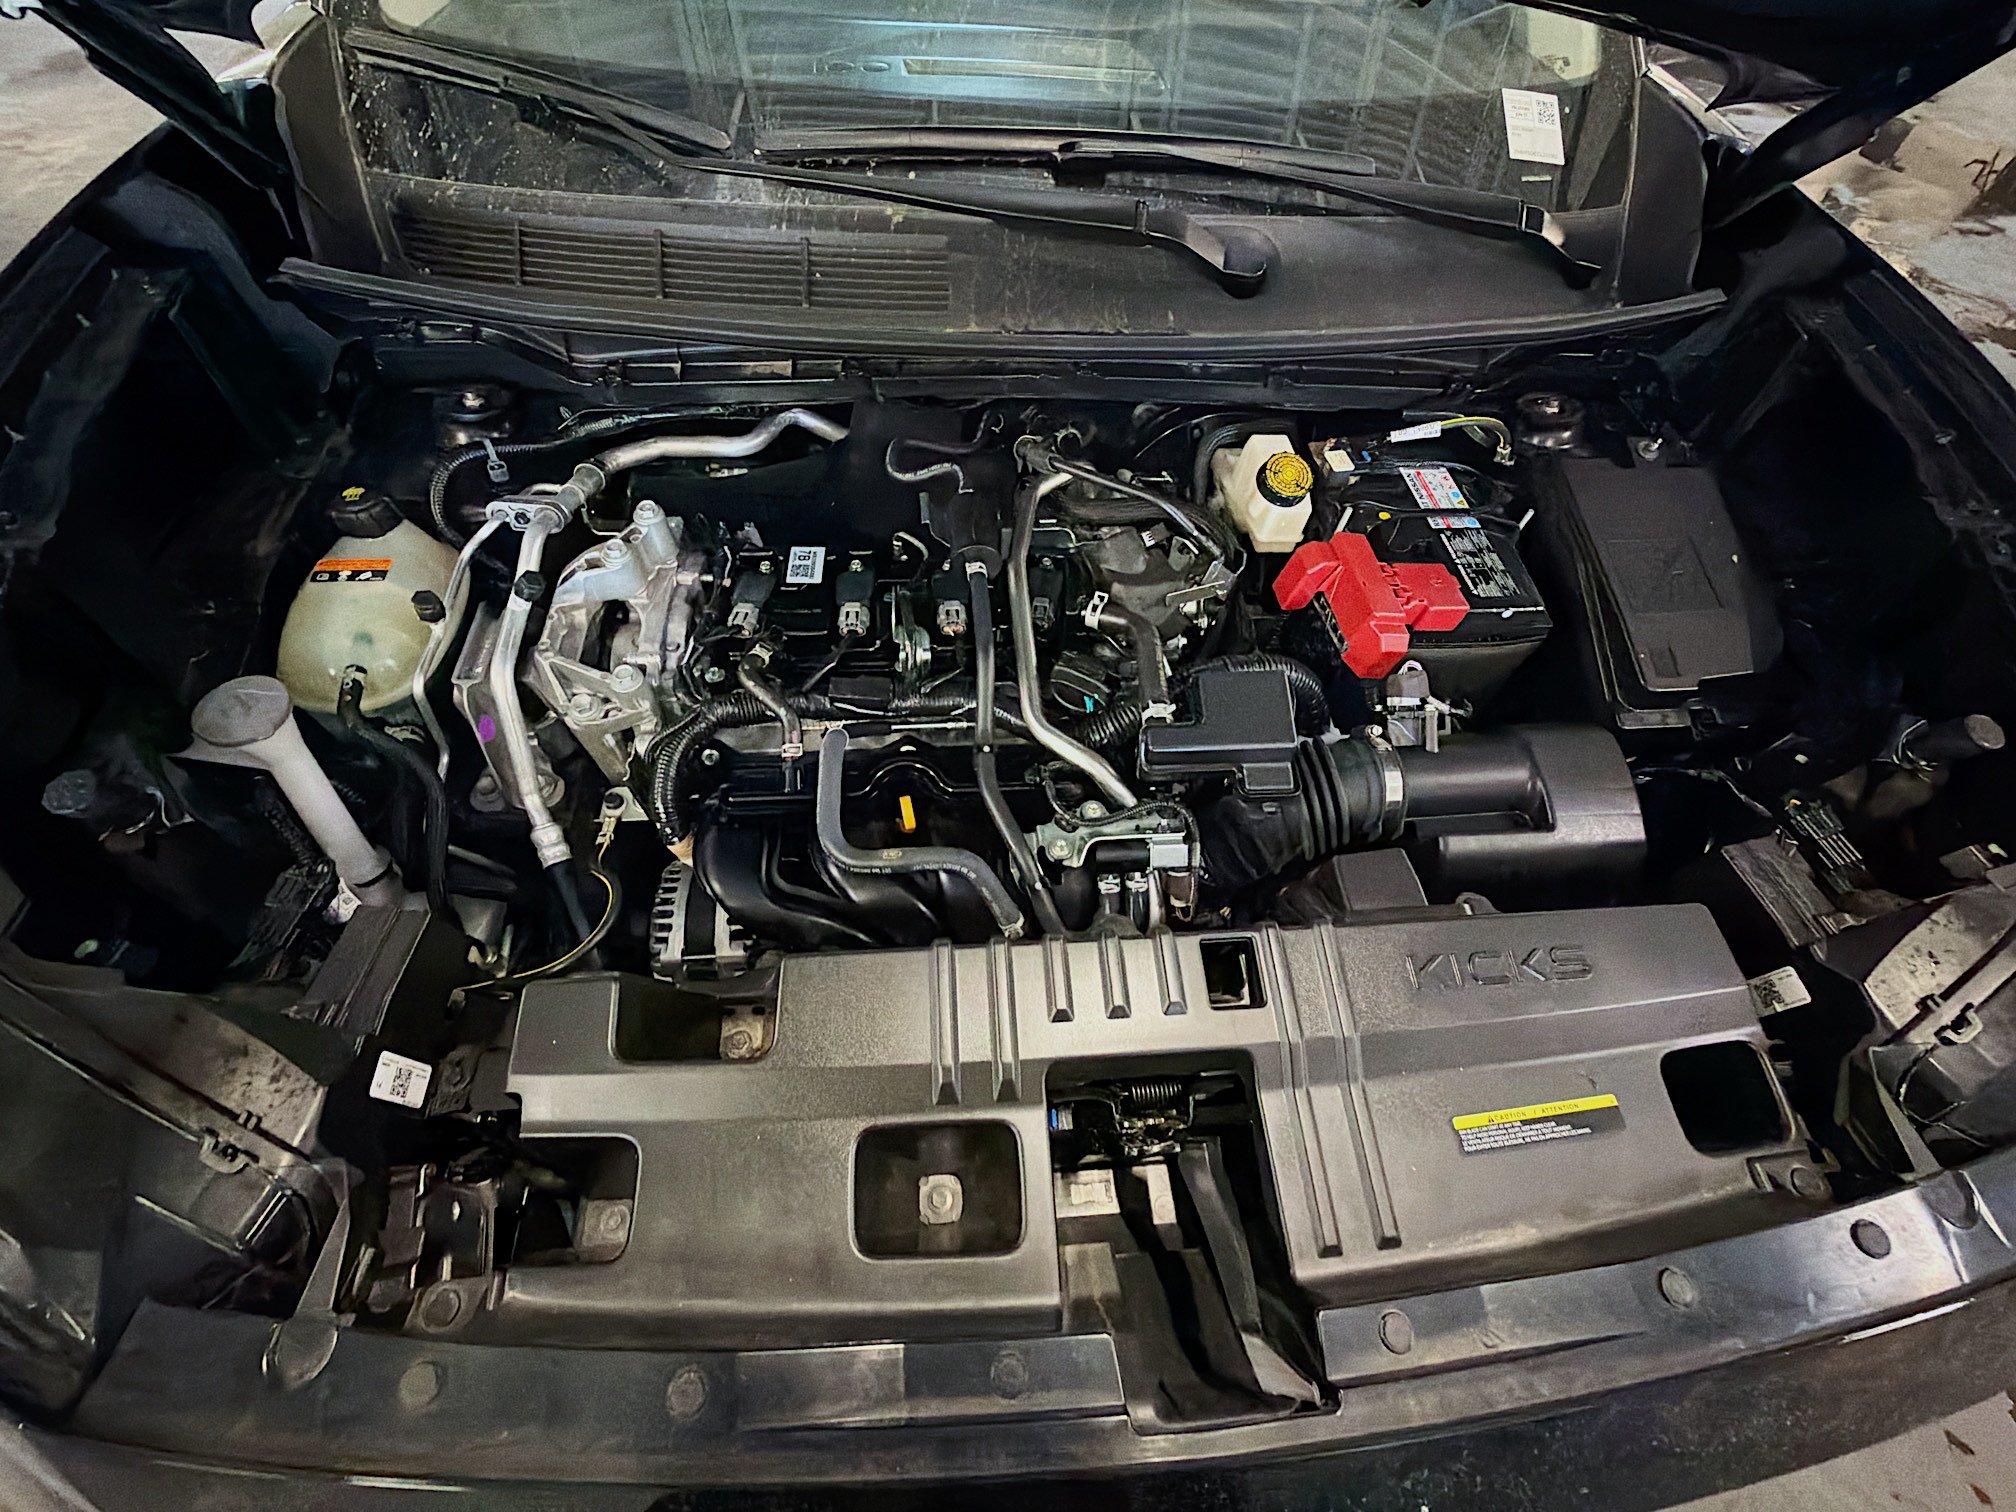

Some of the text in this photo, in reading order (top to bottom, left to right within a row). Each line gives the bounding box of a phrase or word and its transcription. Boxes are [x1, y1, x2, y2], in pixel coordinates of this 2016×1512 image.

[1405, 472, 1426, 500] NISSAN
[1405, 946, 1593, 989] KICKS
[1494, 1111, 1526, 1121] CAUTION
[1541, 1104, 1580, 1114] ATTENTION
